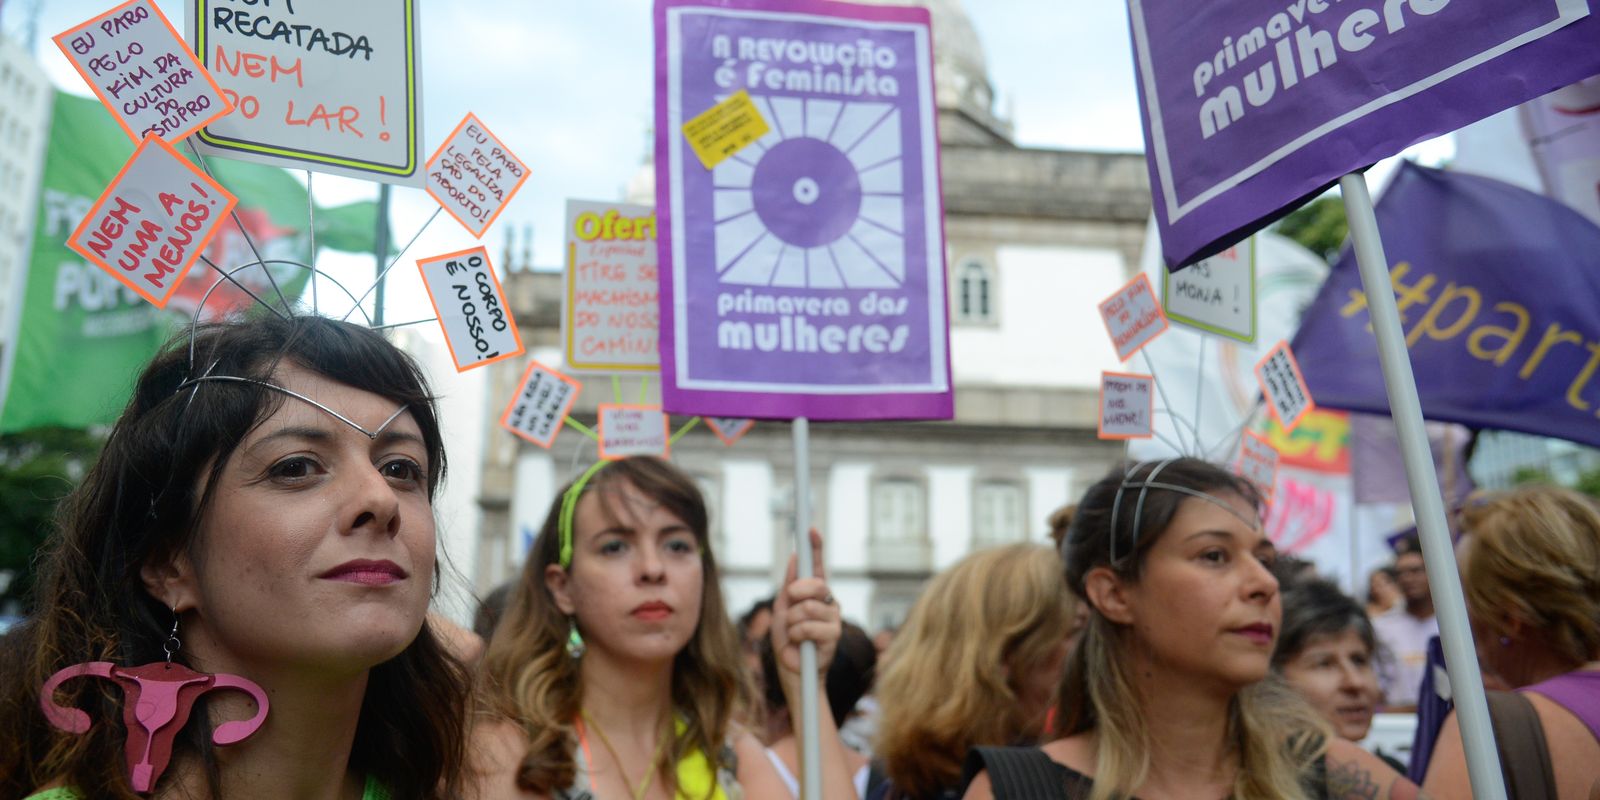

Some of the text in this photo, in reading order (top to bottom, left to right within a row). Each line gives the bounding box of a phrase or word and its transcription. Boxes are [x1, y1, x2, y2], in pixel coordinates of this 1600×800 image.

[71, 6, 149, 55] EU PARO
[213, 7, 374, 61] RECATADA
[712, 34, 897, 70] A REVOLUÇÃO
[1193, 0, 1342, 98] primave
[88, 42, 144, 77] PELO
[153, 52, 182, 74] DA
[215, 44, 304, 89] NEM
[123, 67, 194, 116] CULTURA
[155, 98, 179, 116] DO
[466, 125, 522, 178] EU PARO
[471, 148, 502, 180] PELA
[158, 192, 184, 217] A
[430, 171, 491, 223] ABORTO!
[468, 185, 486, 202] DO
[87, 196, 141, 259] NEM
[144, 182, 216, 289] MENOS!
[445, 260, 500, 360] É NOSSO!
[468, 256, 507, 332] O CORPO
[717, 288, 909, 317] primavera das
[717, 314, 910, 353] mulheres
